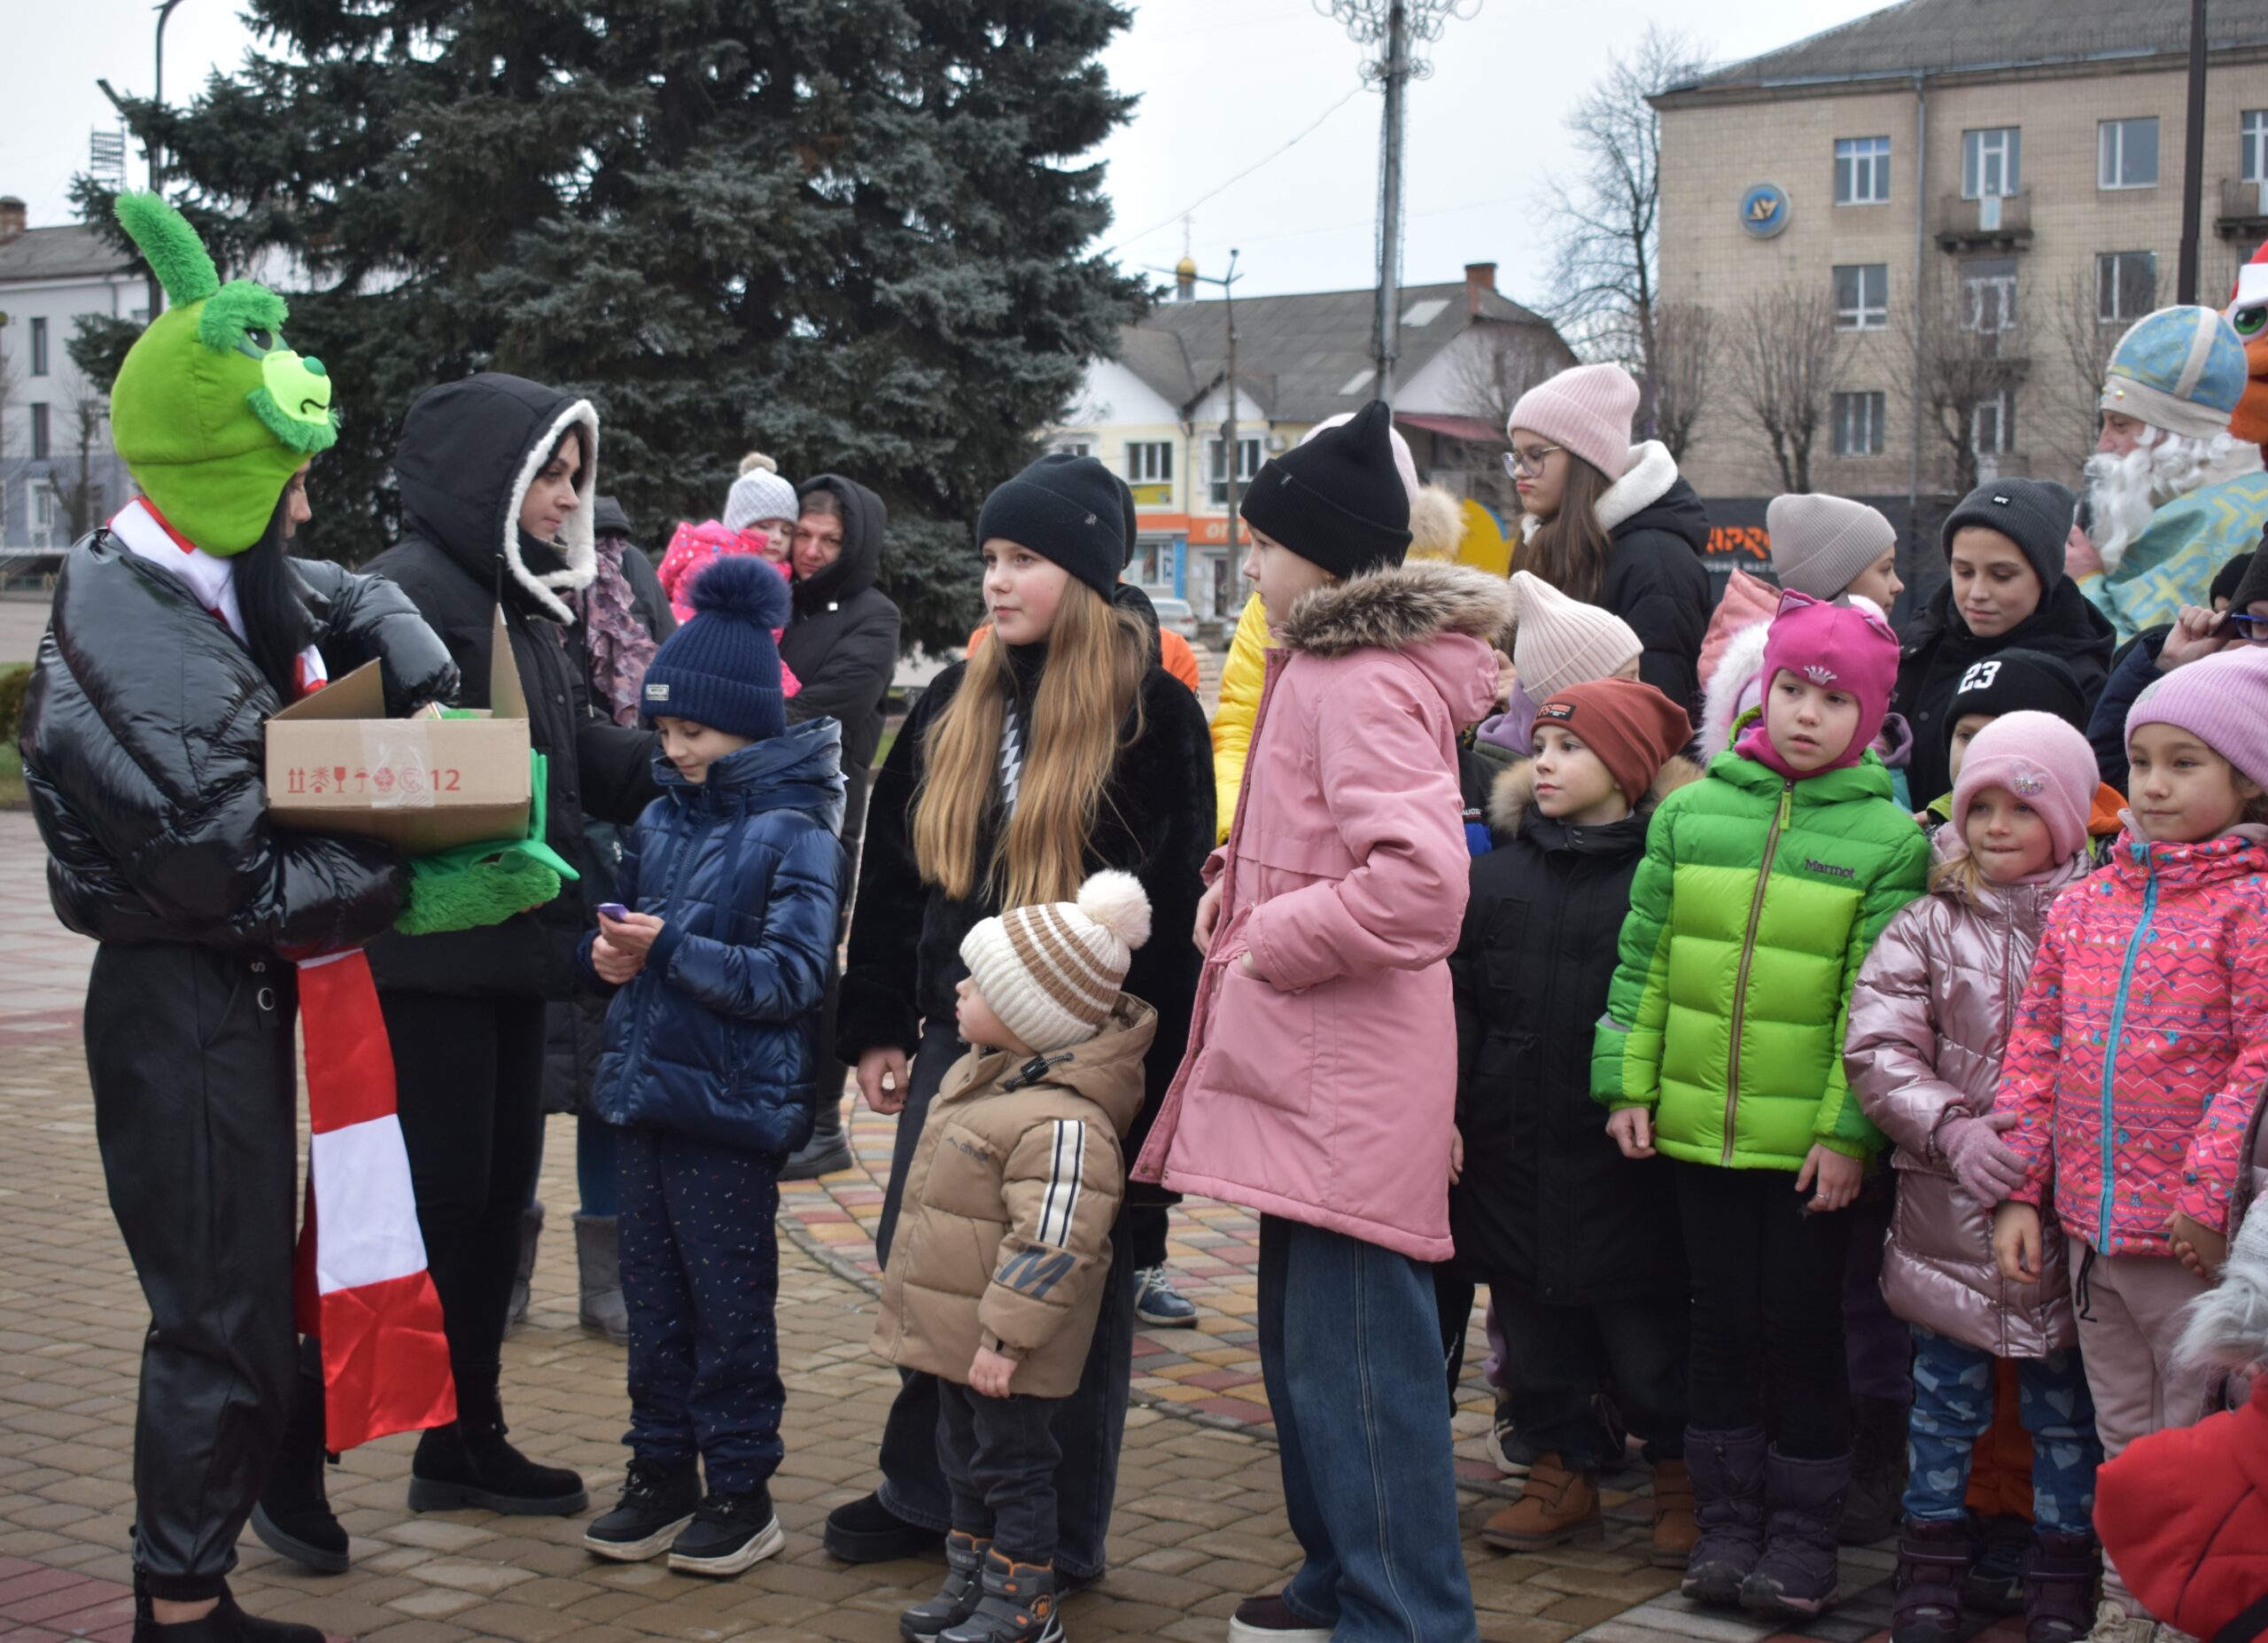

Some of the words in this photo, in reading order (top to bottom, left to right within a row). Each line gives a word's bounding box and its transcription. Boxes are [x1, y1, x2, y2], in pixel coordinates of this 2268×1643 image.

[1957, 660, 2002, 695] 23
[430, 768, 462, 791] 12
[1804, 857, 1855, 879] Marmot
